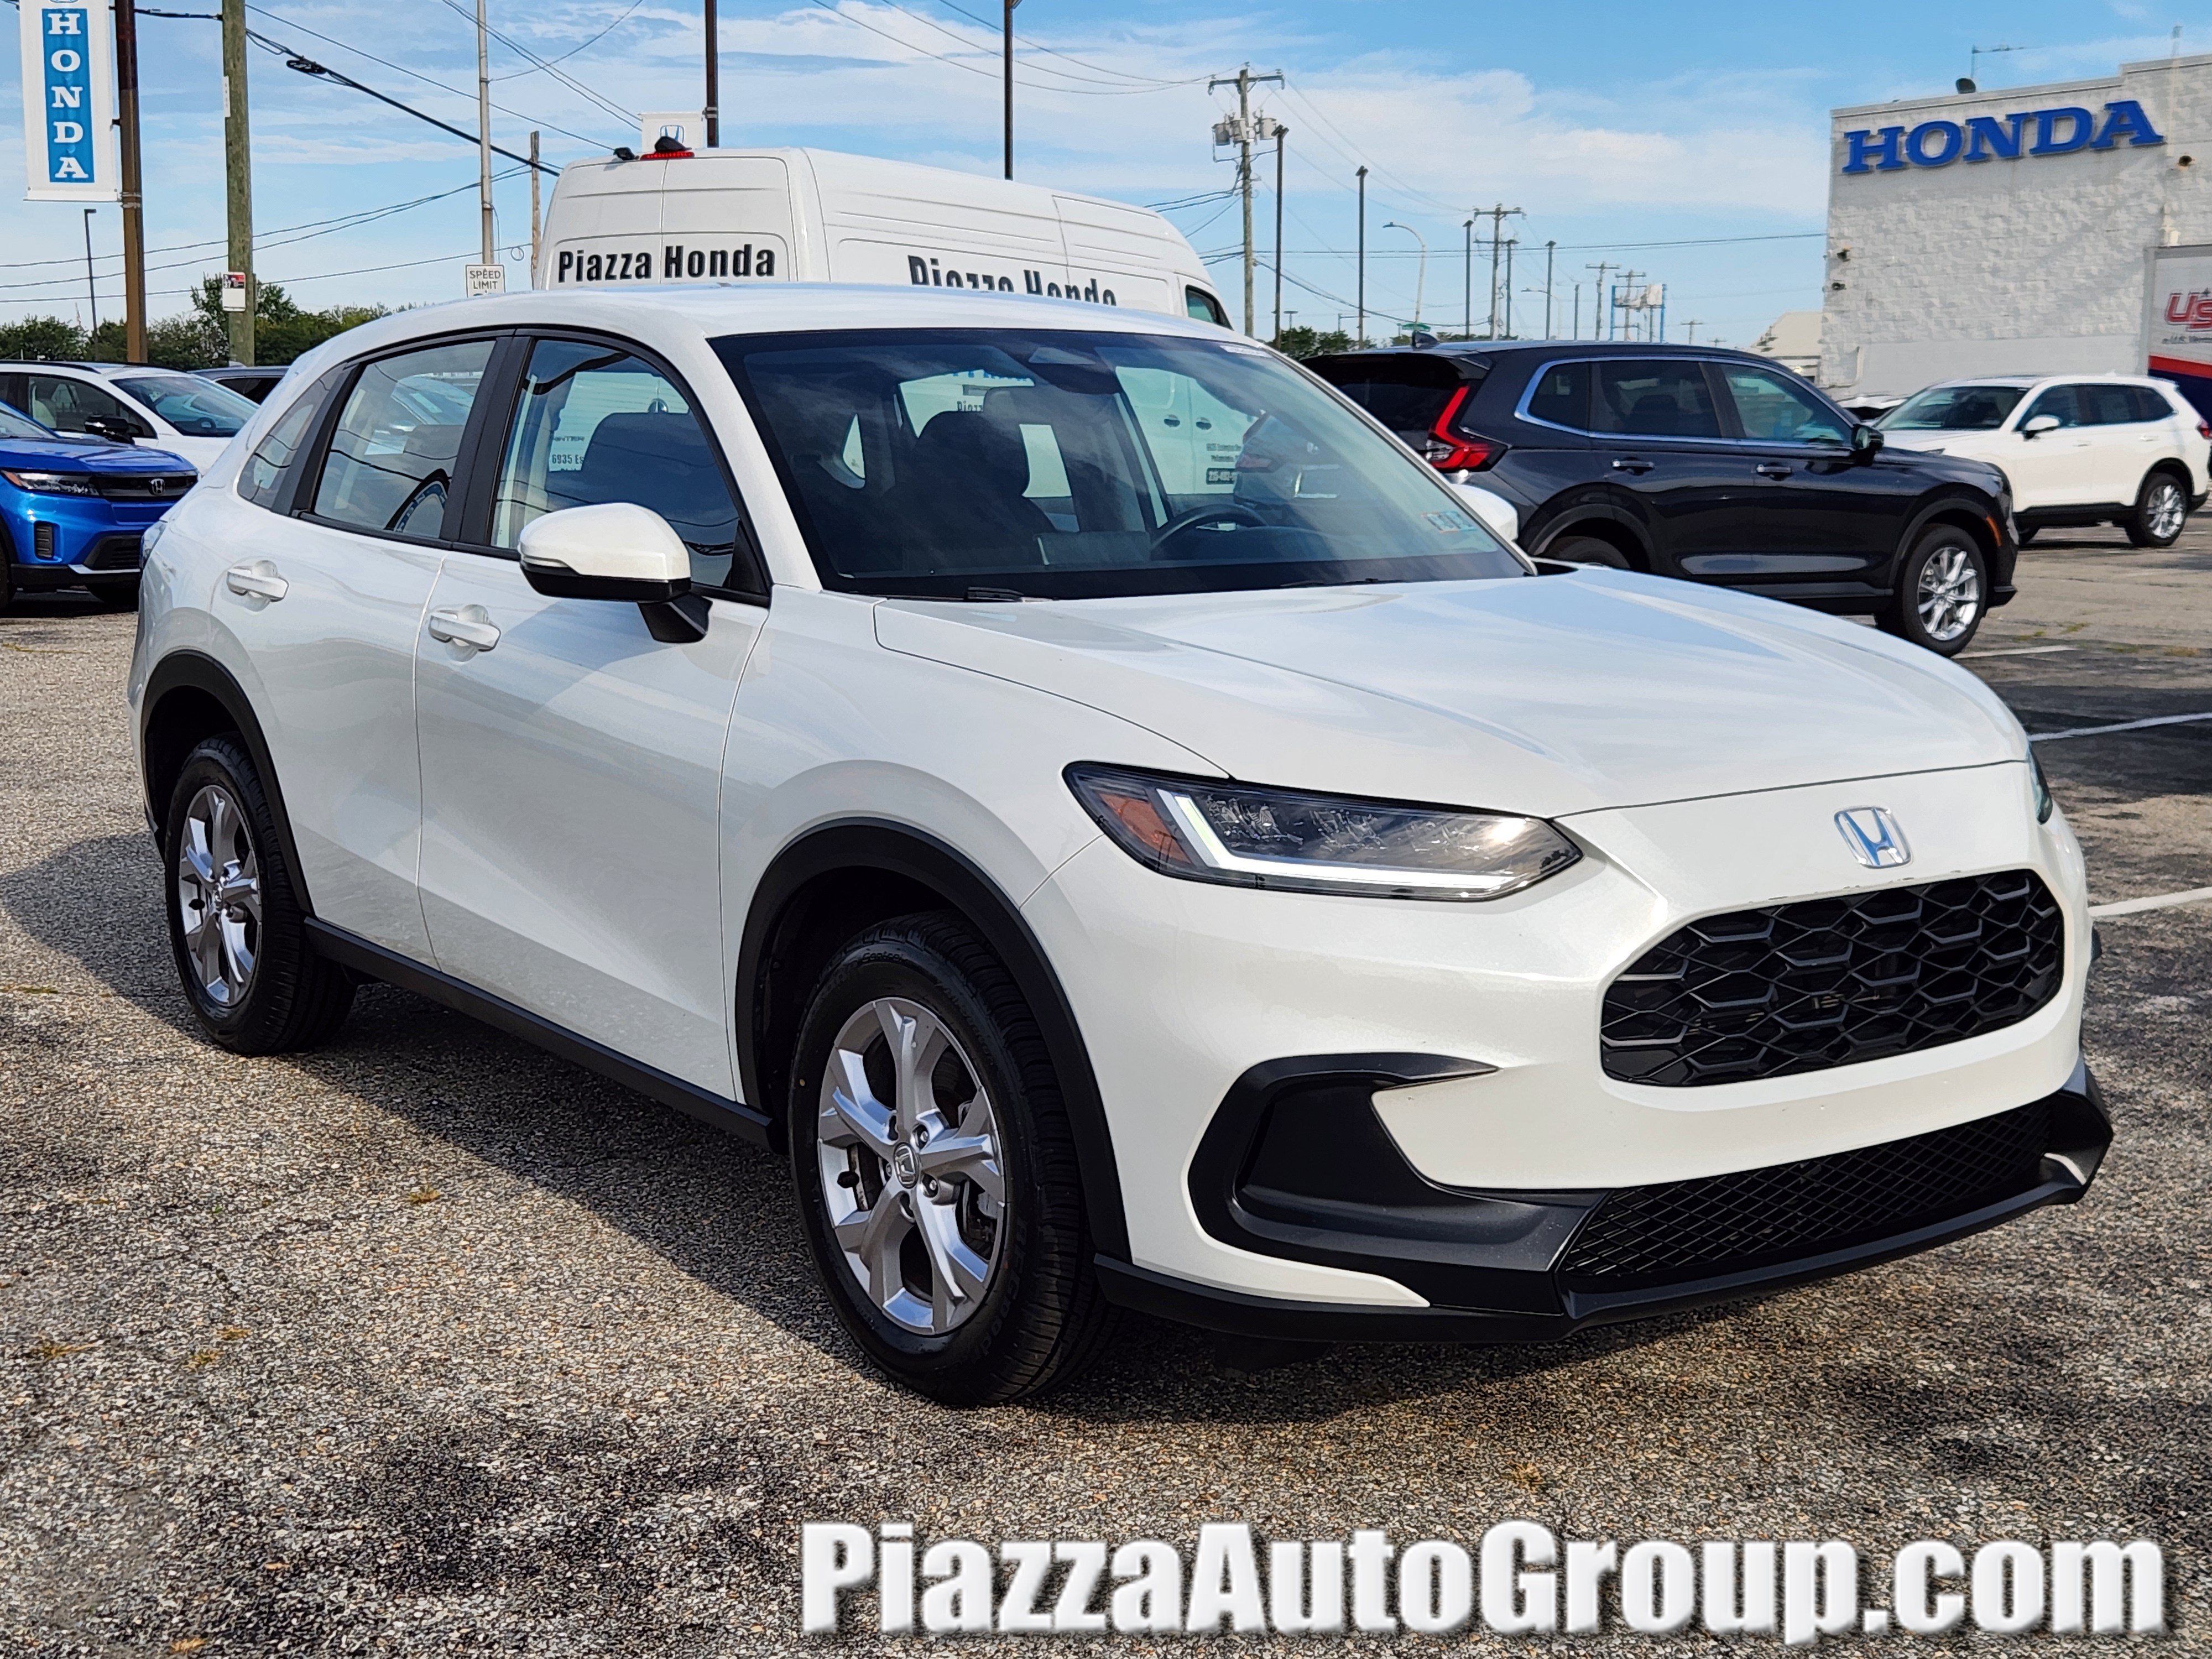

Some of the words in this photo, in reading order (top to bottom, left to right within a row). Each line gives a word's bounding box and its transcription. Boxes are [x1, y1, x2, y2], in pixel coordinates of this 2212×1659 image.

[48, 13, 88, 178] HONDA
[1842, 100, 2164, 173] HONDA
[469, 270, 501, 279] SPEED
[559, 249, 652, 283] Piazza
[664, 244, 775, 278] Honda
[473, 280, 498, 289] LIMIT
[552, 454, 572, 464] 6935
